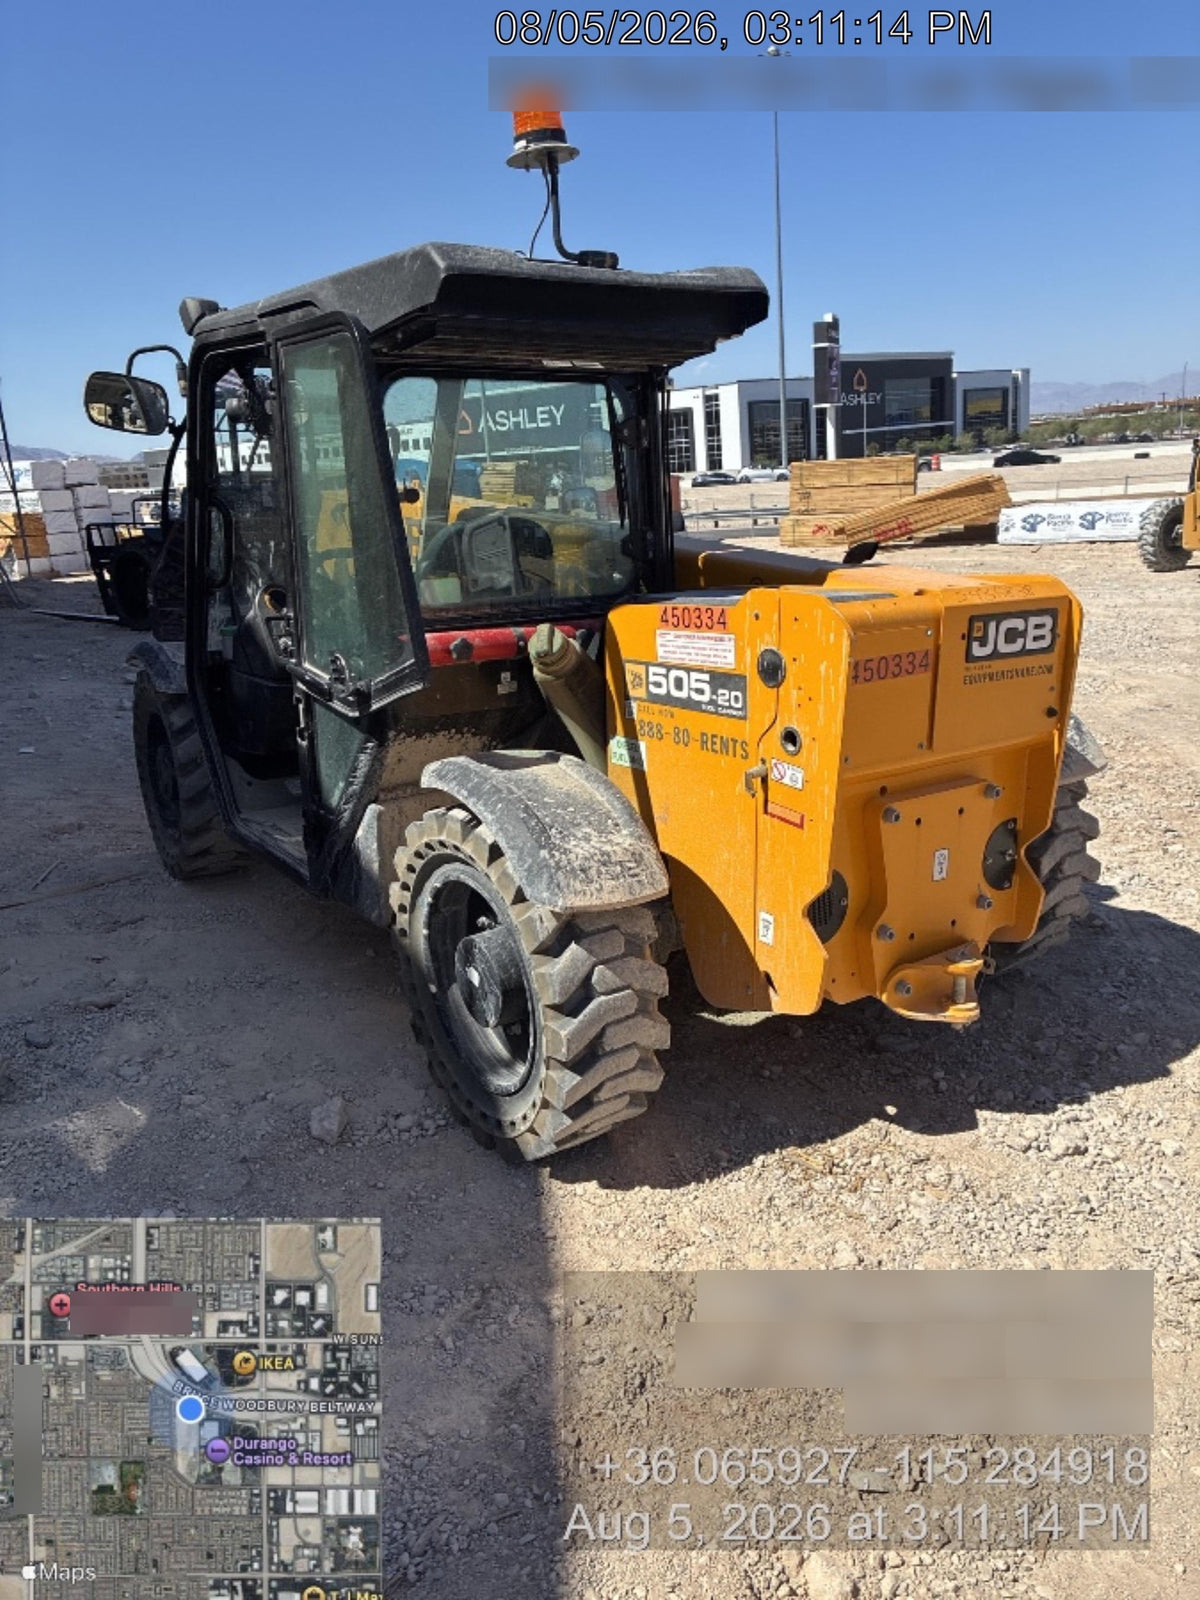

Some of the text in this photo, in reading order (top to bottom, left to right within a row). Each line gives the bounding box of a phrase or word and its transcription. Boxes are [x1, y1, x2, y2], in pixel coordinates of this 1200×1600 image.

[478, 404, 565, 433] ASHLEY
[661, 606, 727, 630] 450334
[972, 615, 1054, 657] JCB
[852, 649, 929, 684] 450334
